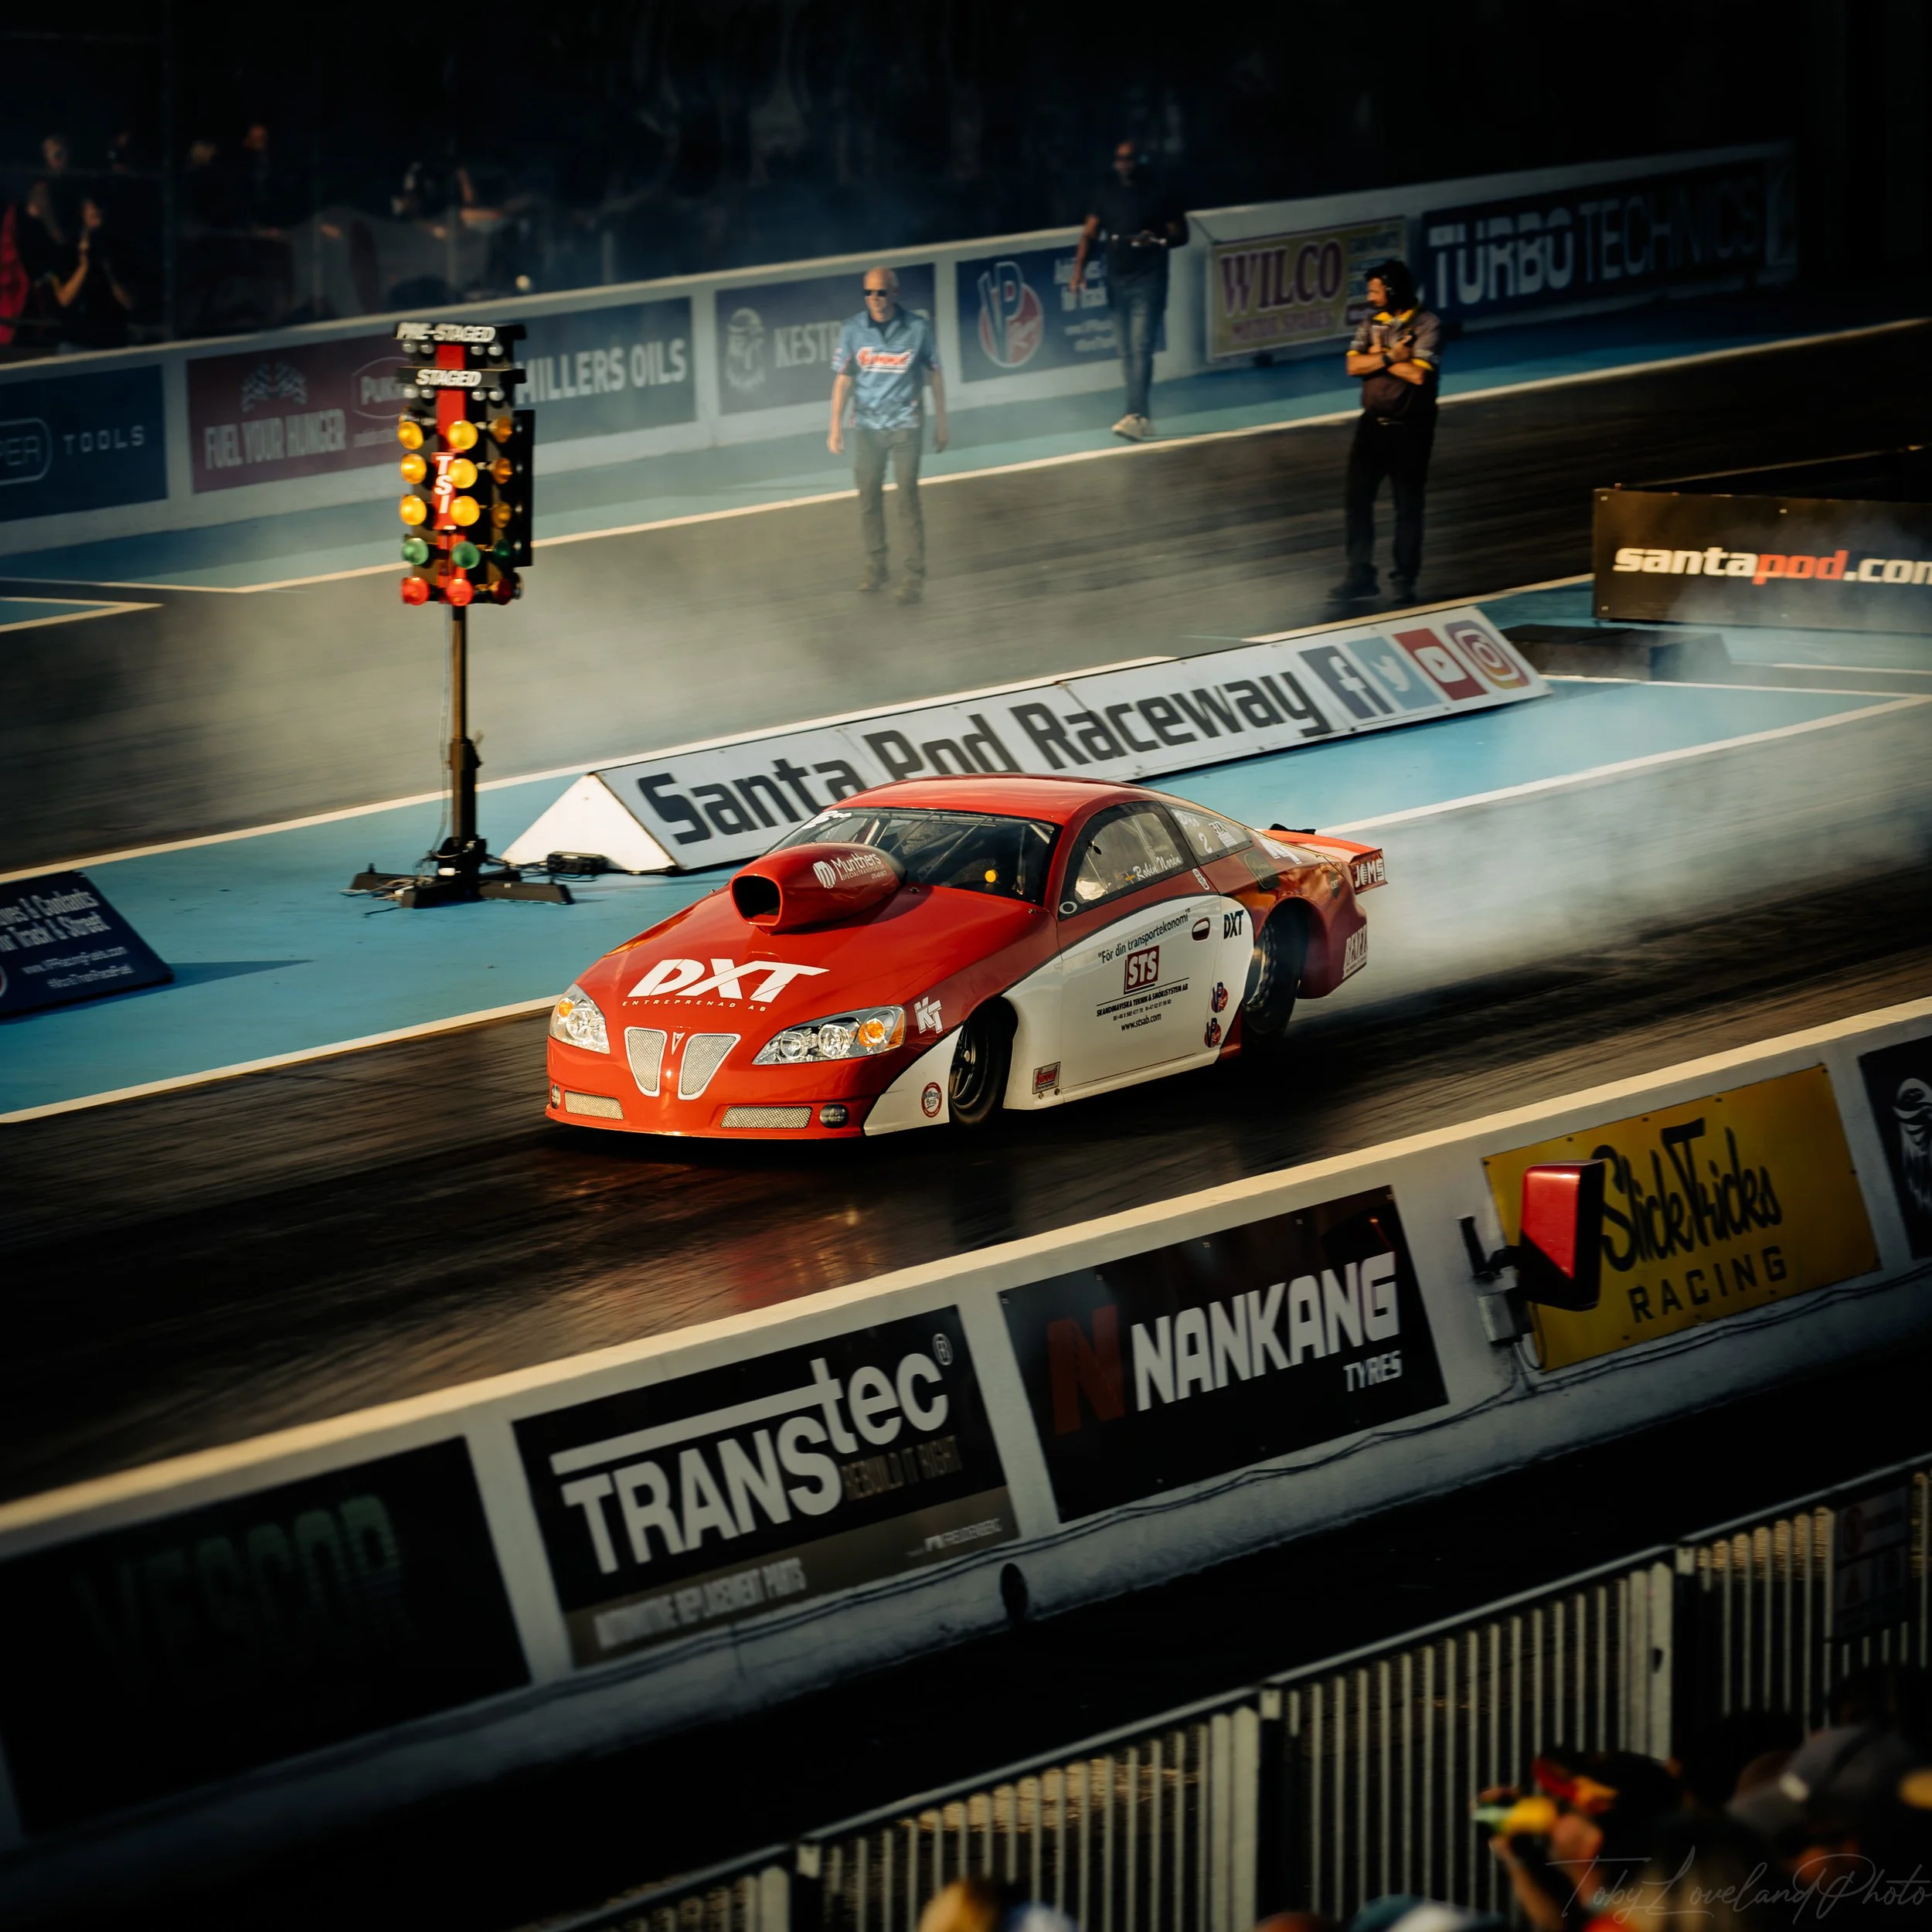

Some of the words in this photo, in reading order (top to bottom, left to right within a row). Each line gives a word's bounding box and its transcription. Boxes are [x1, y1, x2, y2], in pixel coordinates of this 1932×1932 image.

[1427, 206, 1575, 309] TURBO
[1578, 174, 1762, 283] TECHNICS
[1219, 239, 1345, 317] WILCO
[415, 369, 482, 386] STAGED
[630, 338, 687, 388] OILS
[62, 424, 145, 457] TOOLS
[205, 423, 243, 469] FUEL
[242, 417, 285, 464] YOUR
[285, 408, 346, 457] HUNGER
[637, 758, 869, 845] Santa
[862, 713, 1024, 782] Pod
[1009, 672, 1334, 770] Raceway
[830, 852, 883, 881] Munthers
[1132, 862, 1158, 882] Robin
[1223, 910, 1245, 940] DXT
[1115, 944, 1126, 957] din
[1128, 951, 1158, 987] STS
[627, 958, 831, 1003] DXT
[621, 998, 736, 1008] ENTREPRENAD
[747, 1004, 767, 1012] AB
[914, 996, 944, 1034] KT
[1121, 1012, 1162, 1032] www.stsab.com
[1628, 1245, 1787, 1324] RACING
[1131, 1251, 1400, 1412] NANKANG
[1342, 1350, 1403, 1392] TYRES
